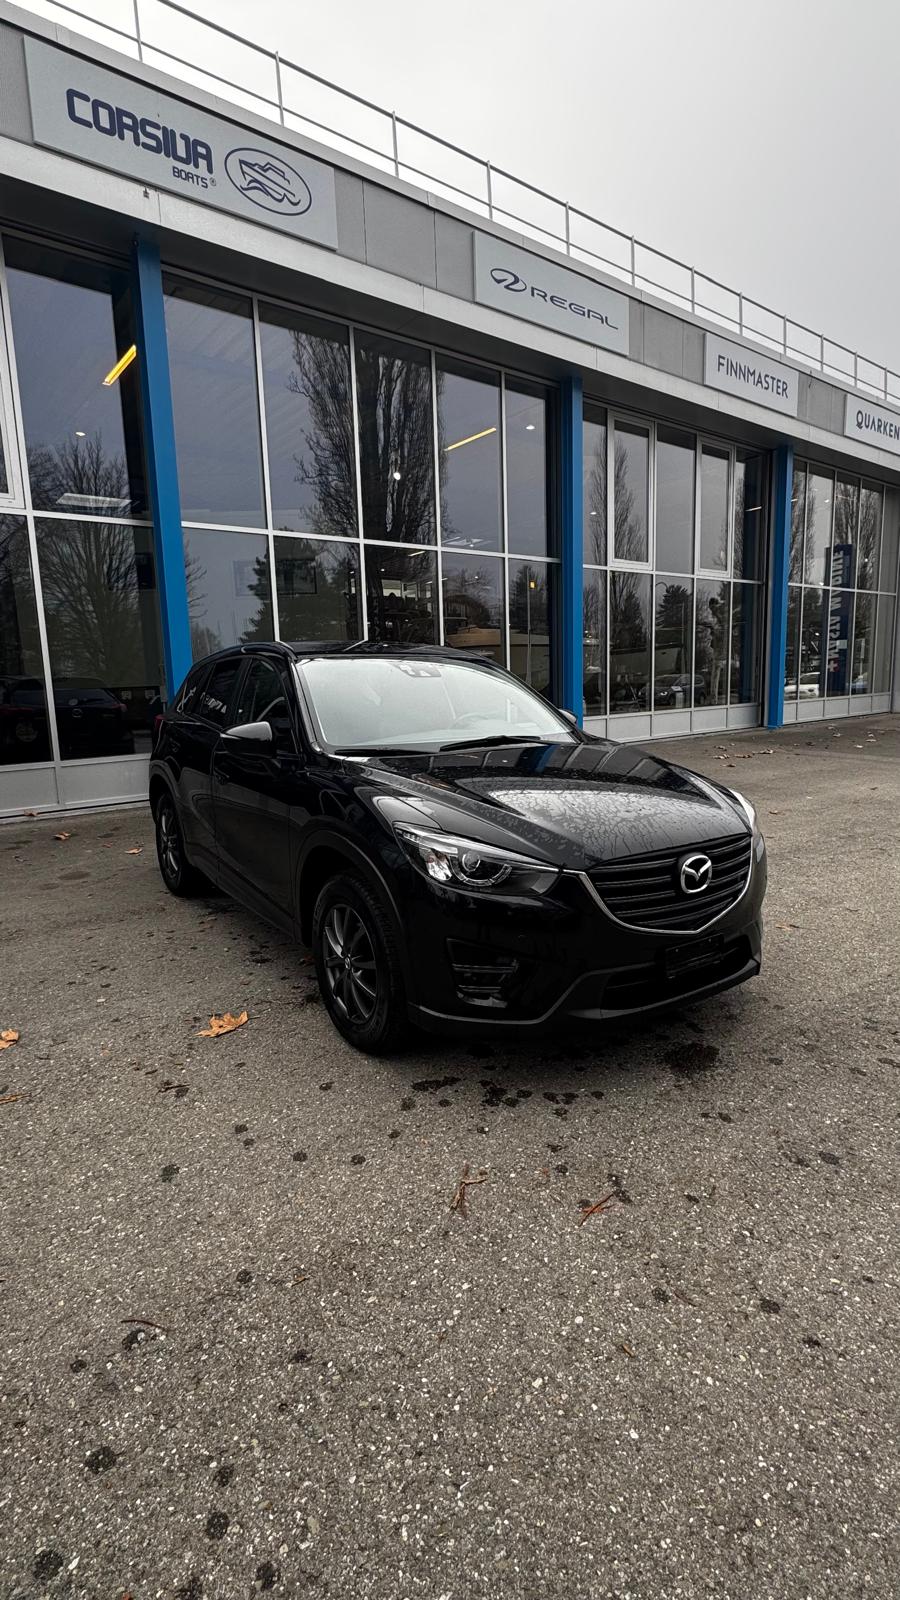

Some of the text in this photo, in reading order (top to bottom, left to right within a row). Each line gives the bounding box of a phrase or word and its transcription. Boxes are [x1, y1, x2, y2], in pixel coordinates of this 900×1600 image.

[66, 88, 213, 175] CORSIVA
[530, 286, 619, 330] REGAL
[718, 355, 789, 399] FINNMASTER
[856, 410, 900, 441] QUARKEN
